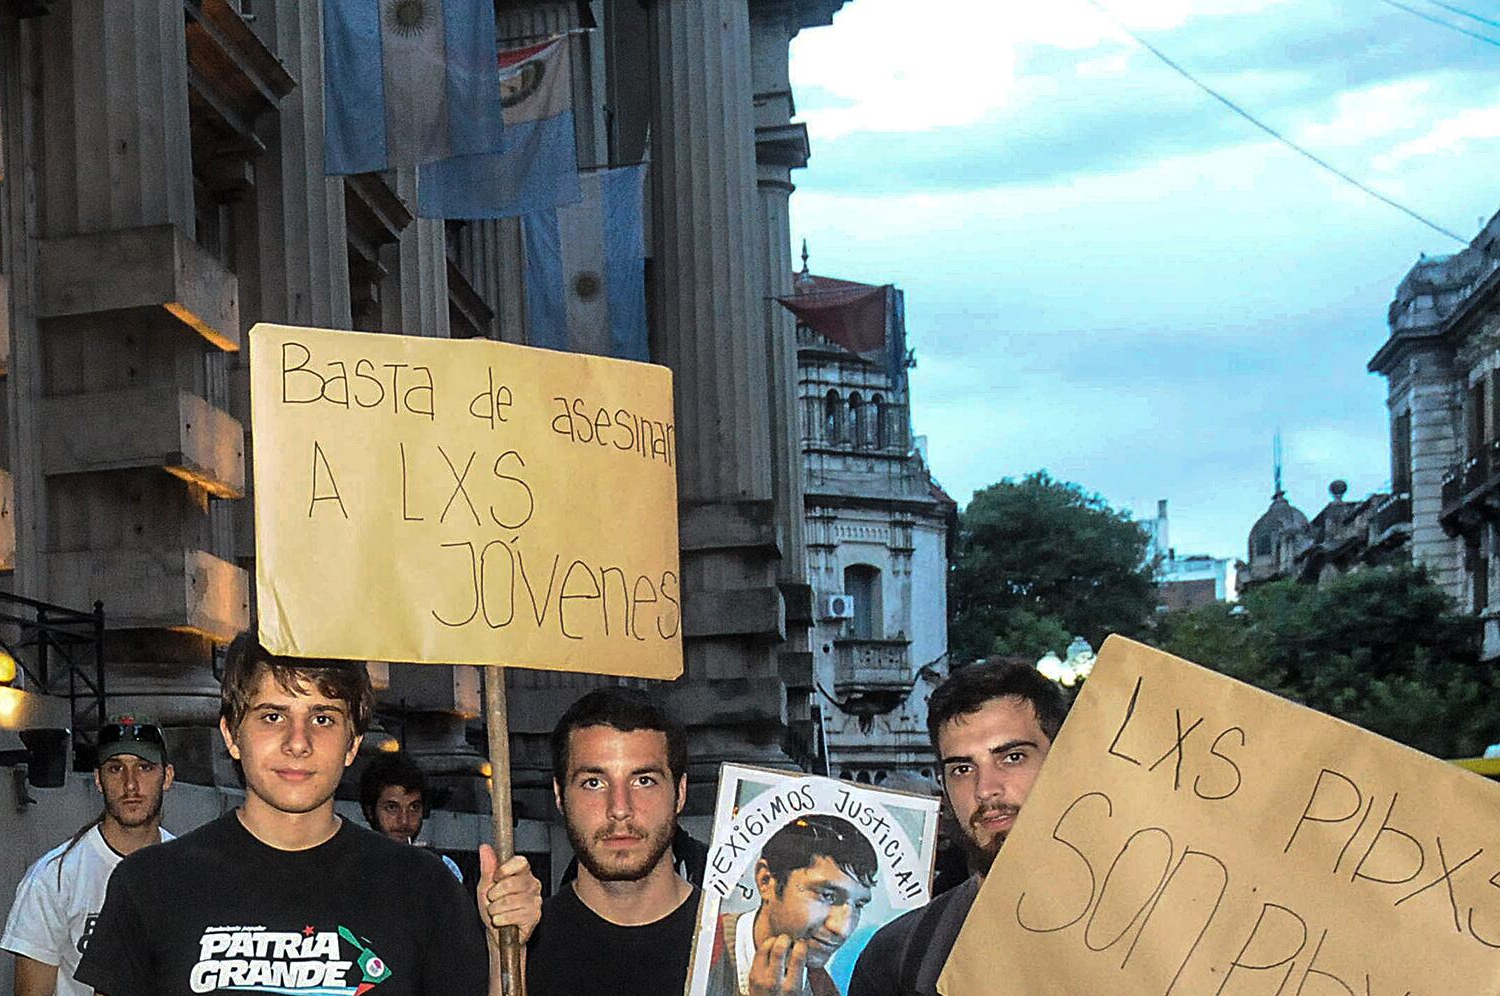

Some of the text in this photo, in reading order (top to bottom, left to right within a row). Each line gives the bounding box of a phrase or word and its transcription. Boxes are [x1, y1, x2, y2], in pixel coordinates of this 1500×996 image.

[469, 366, 513, 430] de
[552, 397, 674, 468] asesinar
[309, 441, 534, 529] A LXS
[1108, 676, 1246, 800] LXS
[189, 959, 353, 994] GRANDE
